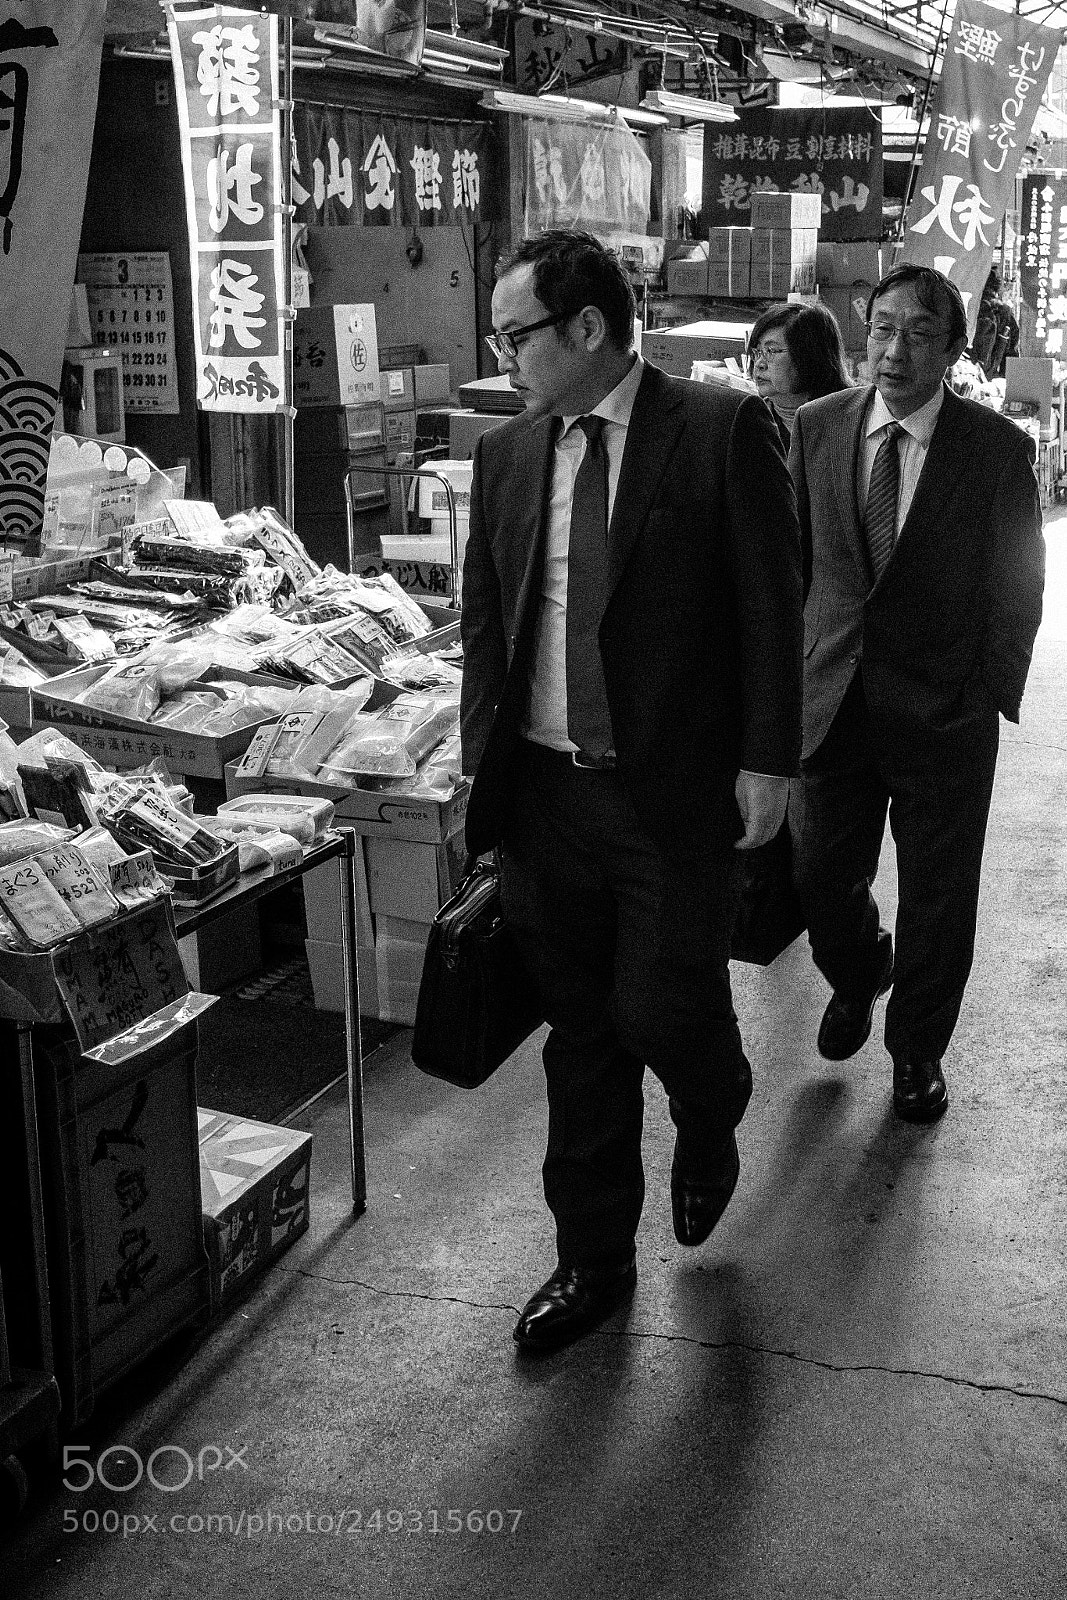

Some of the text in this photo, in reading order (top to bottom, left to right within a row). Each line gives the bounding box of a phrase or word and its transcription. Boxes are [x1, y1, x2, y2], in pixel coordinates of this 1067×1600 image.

[117, 259, 129, 284] 3
[450, 270, 460, 288] 5
[145, 289, 151, 301] 2
[157, 289, 163, 301] 3
[122, 310, 127, 322] 7
[134, 310, 139, 322] 8
[145, 310, 151, 322] 9
[156, 310, 166, 322] 10
[120, 331, 129, 344] 14
[132, 331, 142, 344] 15
[156, 331, 166, 344] 17
[132, 353, 142, 365] 22
[144, 353, 154, 365] 23
[156, 353, 167, 365] 24
[157, 374, 167, 387] 31
